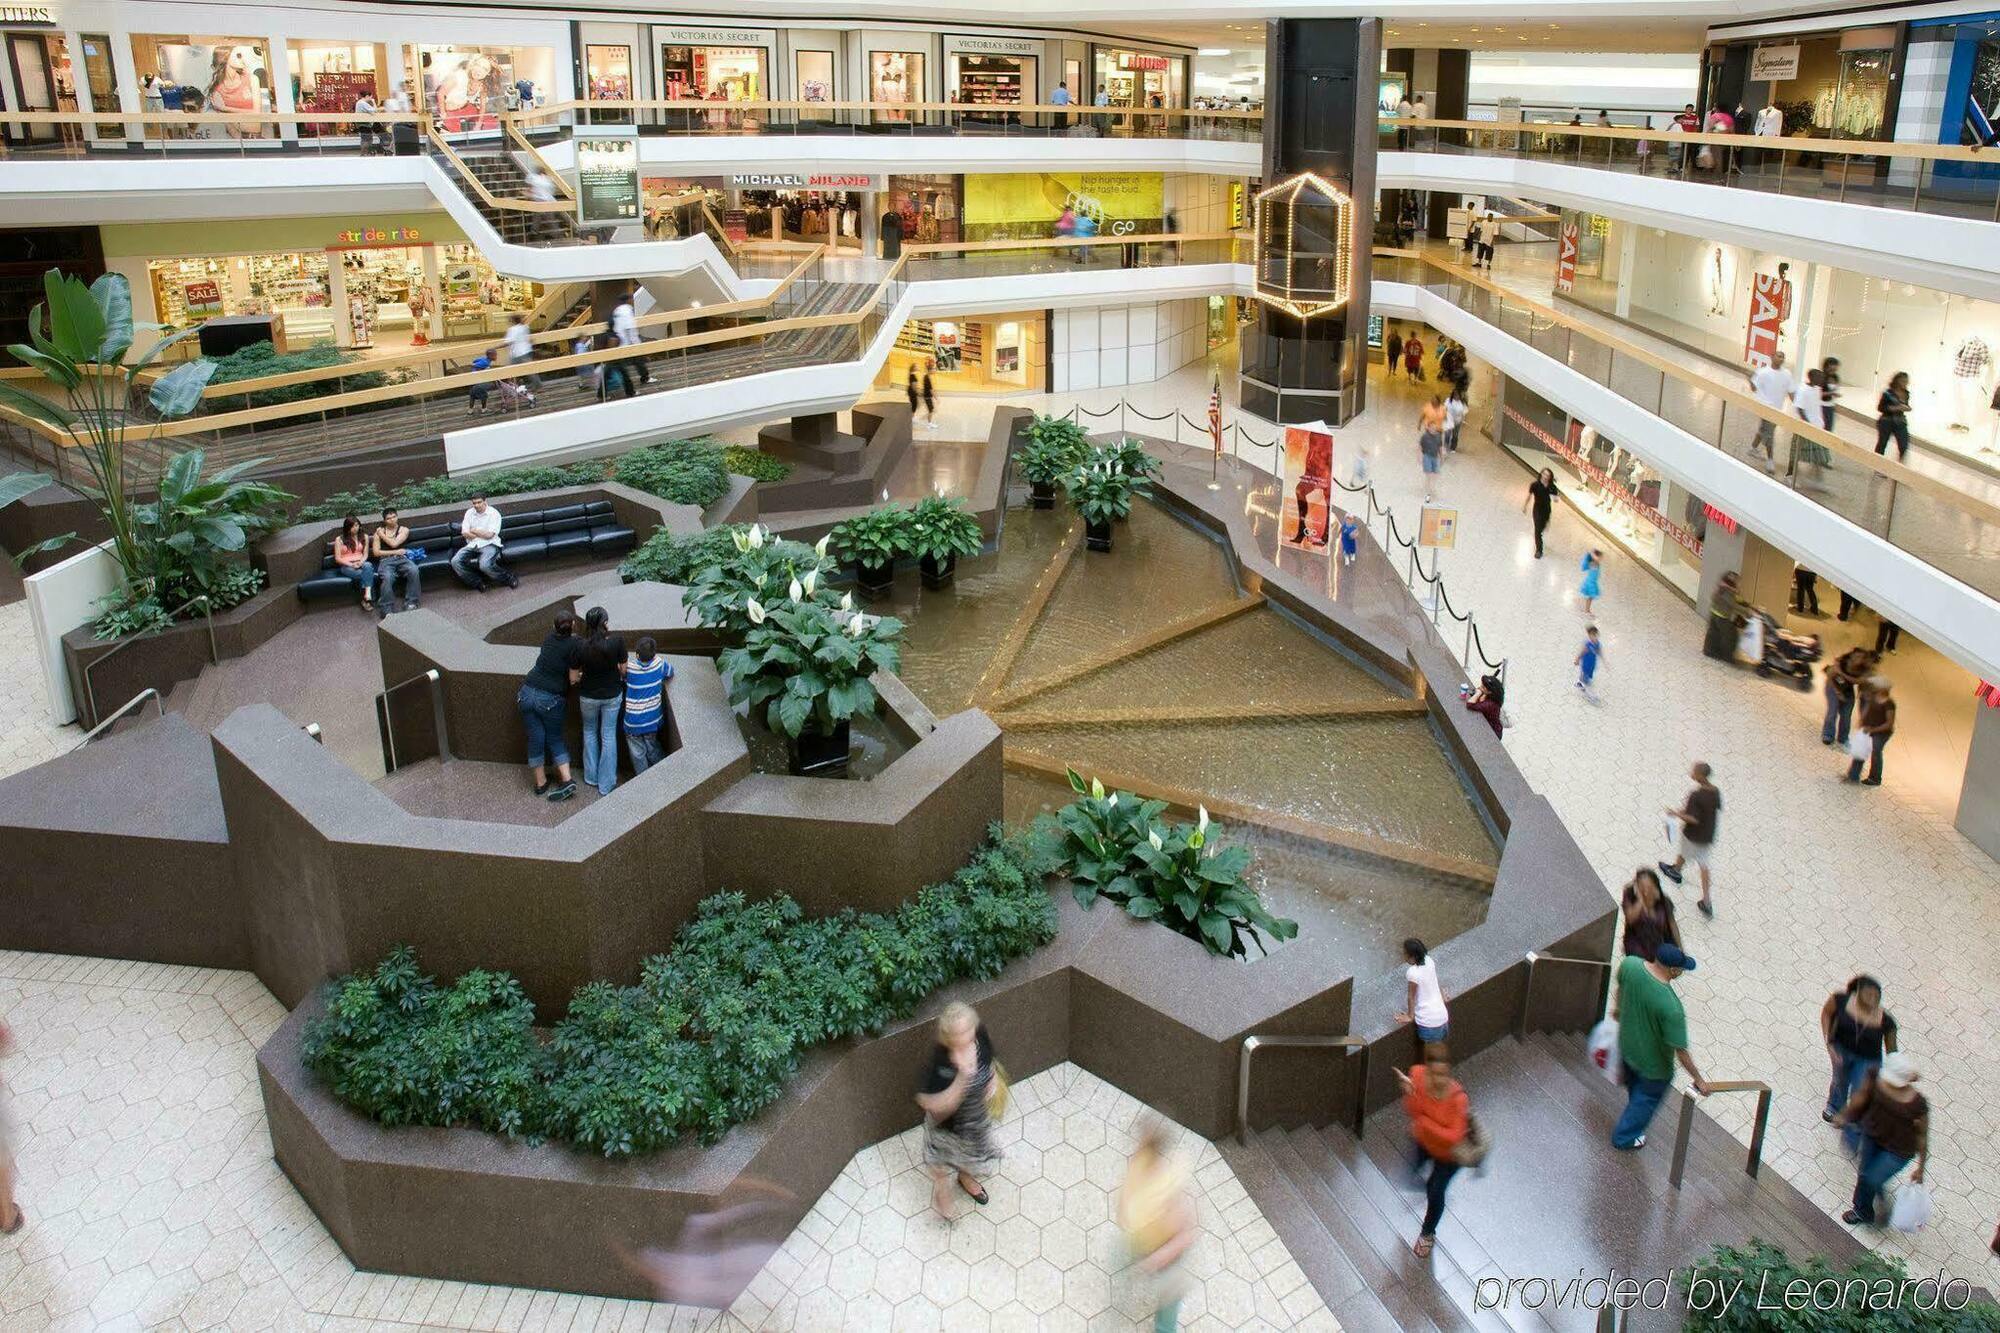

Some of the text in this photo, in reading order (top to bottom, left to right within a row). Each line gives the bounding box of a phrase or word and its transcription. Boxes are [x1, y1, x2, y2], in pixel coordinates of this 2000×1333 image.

[670, 31, 760, 42] VICTORIA'S SECRET
[959, 40, 1033, 51] VICTORIA'S SECRET
[733, 175, 871, 187] MICHAEL MILANO
[1099, 175, 1130, 187] hunger
[1098, 186, 1120, 194] taste
[338, 226, 419, 242] stride rite
[1560, 222, 1578, 293] SALE
[188, 288, 218, 301] SALE
[1747, 273, 1782, 369] SALE
